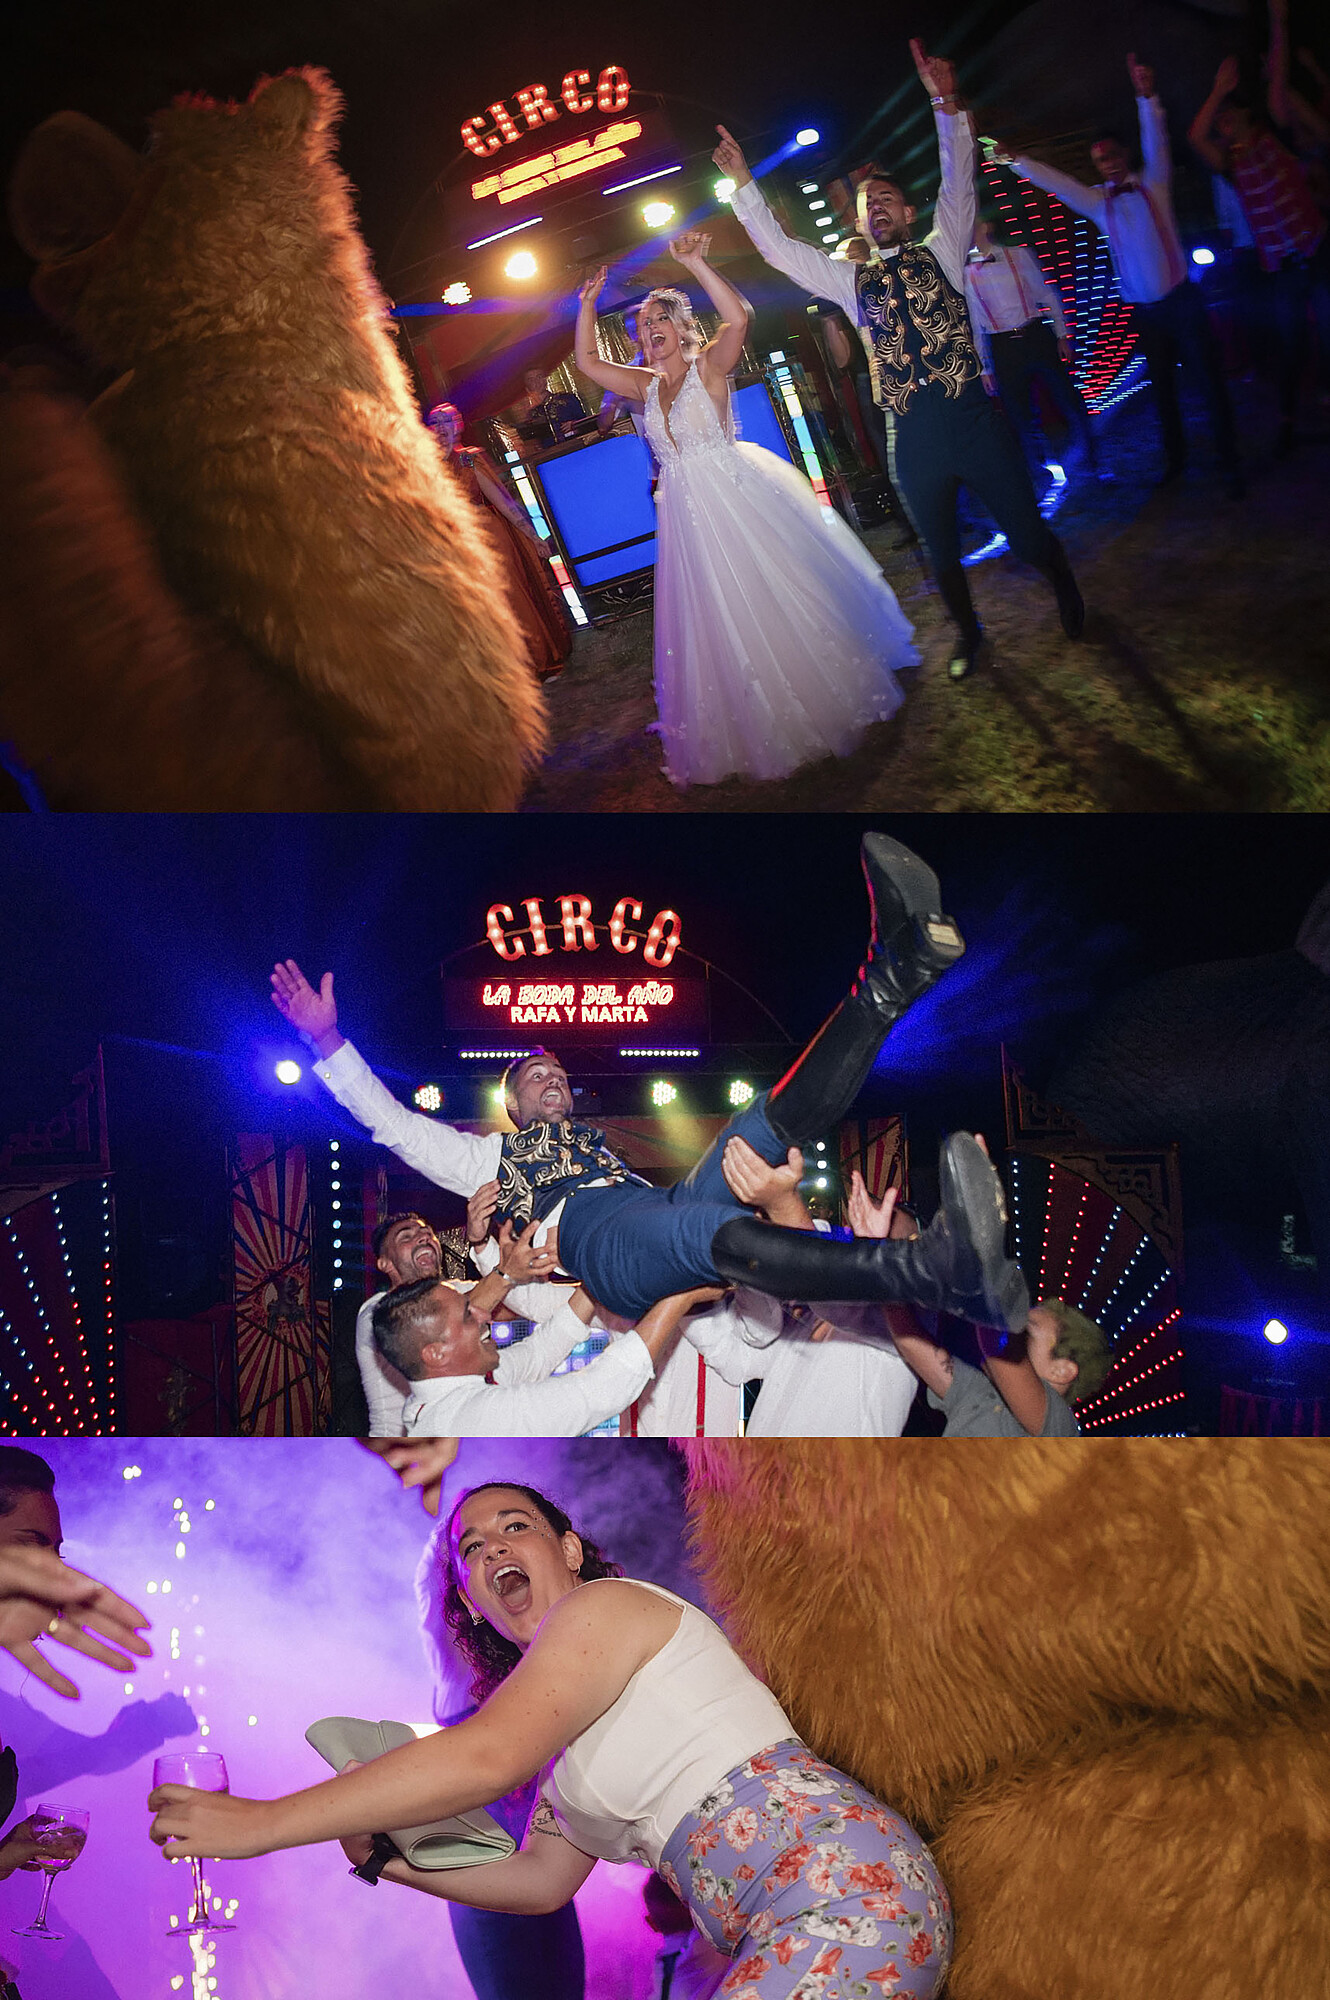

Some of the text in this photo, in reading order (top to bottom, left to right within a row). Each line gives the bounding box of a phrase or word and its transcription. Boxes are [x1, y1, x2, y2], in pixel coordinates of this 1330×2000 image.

[461, 66, 631, 157] CIRCO
[486, 893, 682, 968] CIRCO
[482, 981, 674, 1005] LA BODA DEL AÑO
[510, 1006, 648, 1023] RAFA Y MARTA
